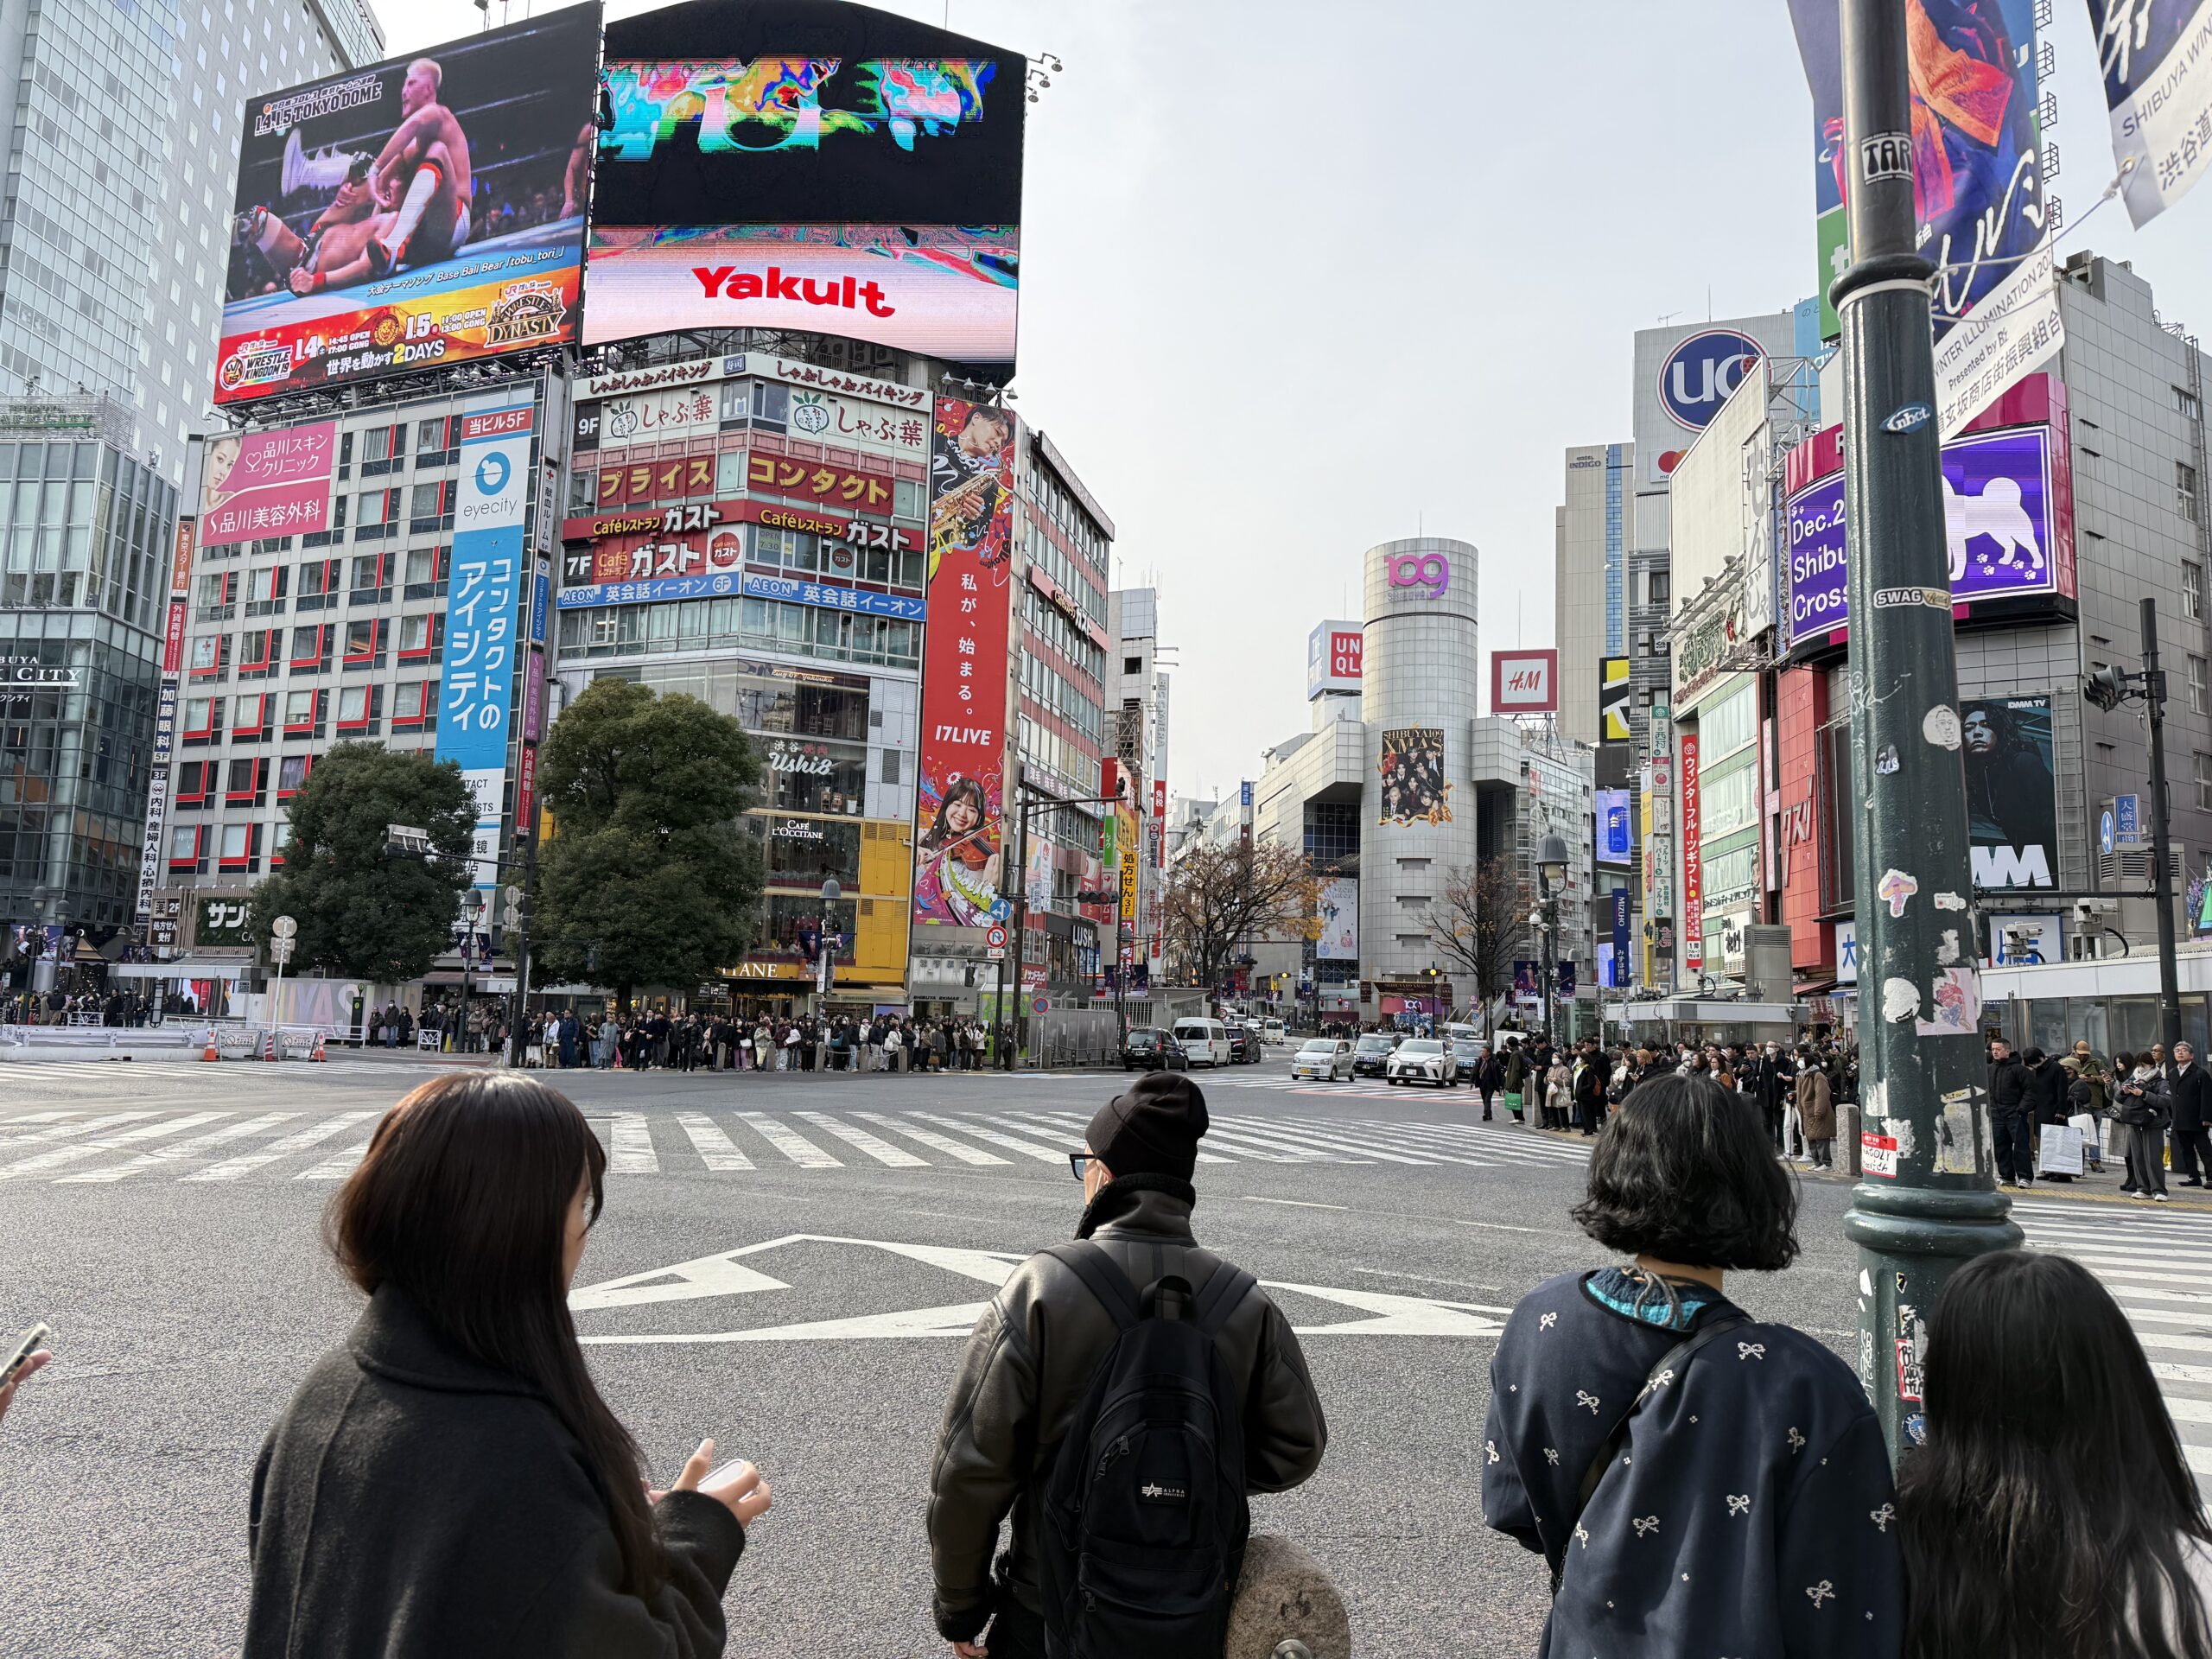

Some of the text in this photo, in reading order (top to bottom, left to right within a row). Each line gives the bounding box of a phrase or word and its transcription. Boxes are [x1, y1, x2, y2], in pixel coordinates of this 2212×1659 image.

[294, 95, 340, 122] TOKYO
[340, 82, 383, 110] DOME
[2122, 60, 2188, 137] SHIBUYA
[366, 273, 434, 297] 大会テーマソング
[435, 270, 460, 283] Base
[461, 264, 480, 277] Ball
[481, 260, 504, 273] Bear
[691, 265, 897, 318] Yakult
[464, 308, 487, 320] OPEN
[1961, 270, 2037, 348] ILLUMINATION
[349, 330, 371, 343] OPEN
[405, 312, 431, 340] 1.5
[490, 313, 561, 344] DYNASTY
[246, 351, 291, 369] WRESTLE
[294, 334, 319, 361] 1.4
[327, 342, 347, 354] 17:00
[327, 340, 445, 376] 世界を動かす 2DAYS
[245, 362, 290, 381] KINGDOM 19
[589, 361, 712, 395] しゃぶしゃぶバイキング
[1948, 347, 1986, 391] Presented
[1986, 340, 1997, 356] by
[777, 360, 925, 405] しゃぶしゃぶバイキング
[468, 416, 526, 435] 当ビル5F
[578, 416, 599, 435] 9F
[642, 394, 712, 429] しゃぶ葉
[838, 406, 924, 448] しゃぶ葉
[263, 435, 328, 458] 品川スキン
[262, 454, 320, 478] クリニック
[601, 459, 714, 499] プライス
[749, 456, 892, 505] コンタクト
[219, 499, 321, 533] 品川美容外科
[463, 496, 518, 519] eyecity
[542, 486, 553, 543] 献血ルーム
[664, 504, 721, 532] ガスト
[759, 531, 780, 540] OPEN
[846, 520, 910, 552] ガスト
[176, 533, 189, 588] 東京スター銀行
[567, 556, 592, 576] 7F
[598, 551, 628, 569] Café
[630, 542, 700, 579] ガスト
[714, 547, 739, 558] ガスト
[834, 554, 851, 563] ガスト
[563, 576, 730, 604] AEON 英会話イーオン 6F
[1383, 553, 1449, 599] 109
[748, 577, 922, 616] AEON 英会話イーオン
[1878, 590, 1922, 606] SWAG
[170, 604, 183, 641] 外貨両替
[448, 561, 489, 732] アイシティ
[480, 558, 512, 731] コンタクトの
[957, 573, 978, 715] 私が、始まる。
[1336, 638, 1360, 655] UN
[1336, 656, 1363, 675] QL
[1508, 671, 1541, 691] H&M
[527, 668, 540, 727] 品川美容外科
[2007, 699, 2046, 709] DMM TV
[156, 688, 175, 748] 加藤眼科
[156, 753, 168, 761] 5F
[774, 740, 800, 753] 渋谷
[1382, 737, 1444, 755] XMAS
[153, 771, 166, 779] 3F
[523, 748, 534, 792] 外貨両替
[769, 751, 834, 776] Ushi8
[149, 797, 162, 817] 内科
[1154, 789, 1164, 808] 免税
[1684, 757, 1697, 887] ウィンターフルーツギフト
[1122, 852, 1135, 897] 処方せん
[1123, 899, 1132, 914] 3F
[152, 921, 178, 931] 処方せん
[157, 932, 171, 943] 受付
[1072, 925, 1094, 948] LUSH
[1617, 949, 1625, 982] みずほ銀行
[1404, 999, 1422, 1012] 109
